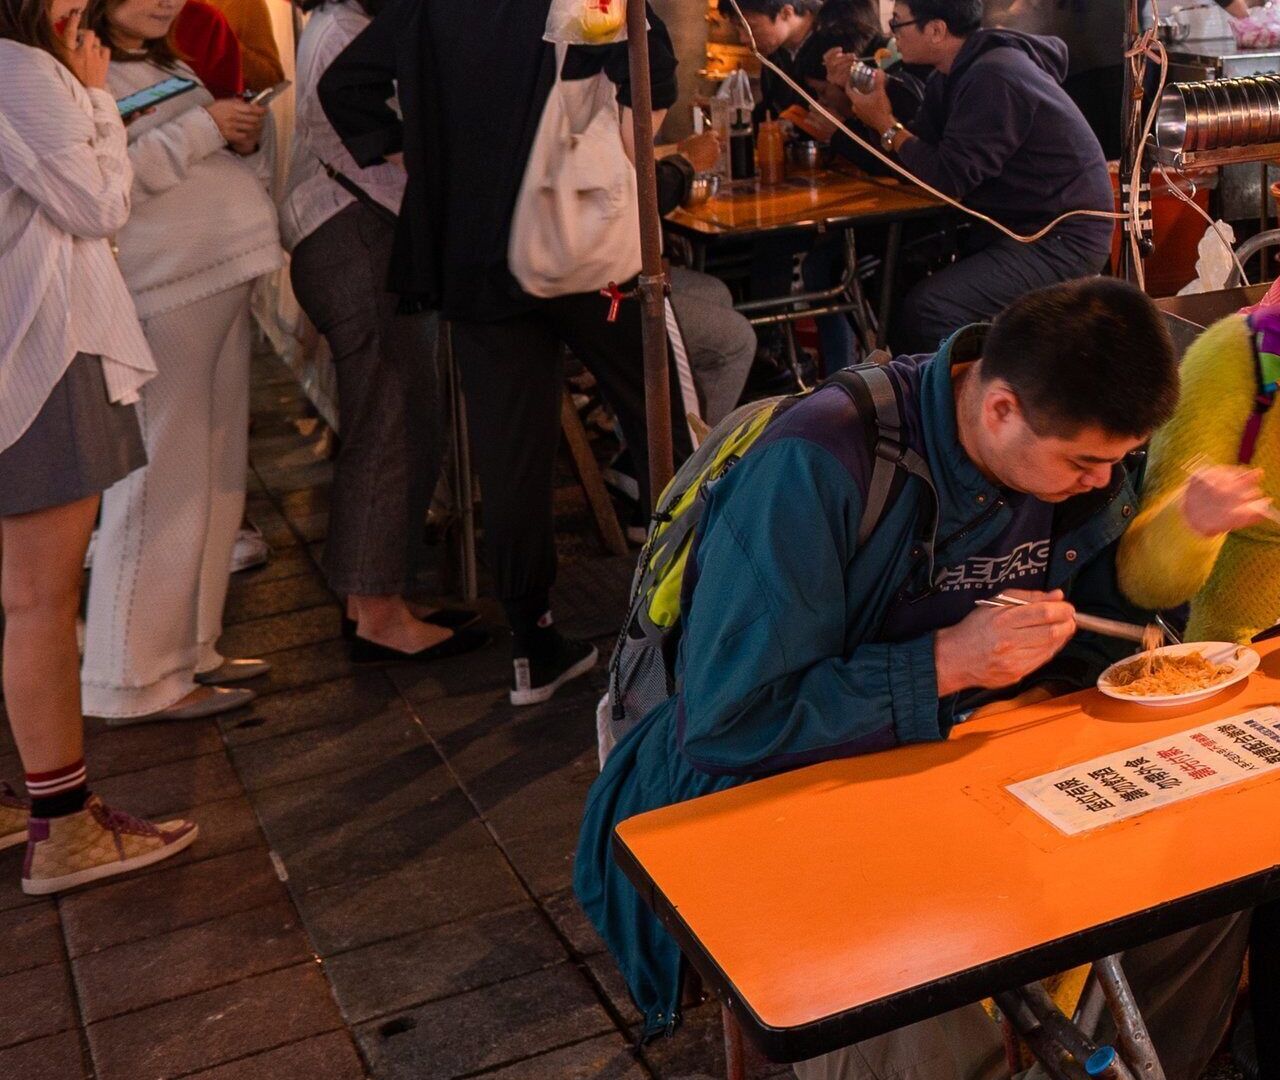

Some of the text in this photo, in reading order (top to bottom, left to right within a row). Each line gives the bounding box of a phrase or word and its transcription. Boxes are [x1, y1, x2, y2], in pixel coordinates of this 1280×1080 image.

[1118, 754, 1186, 792] 勿帶外食
[1152, 744, 1220, 781] 請先付款
[1053, 776, 1117, 814] 座位有限
[1084, 764, 1152, 803] 請勿飲酒
